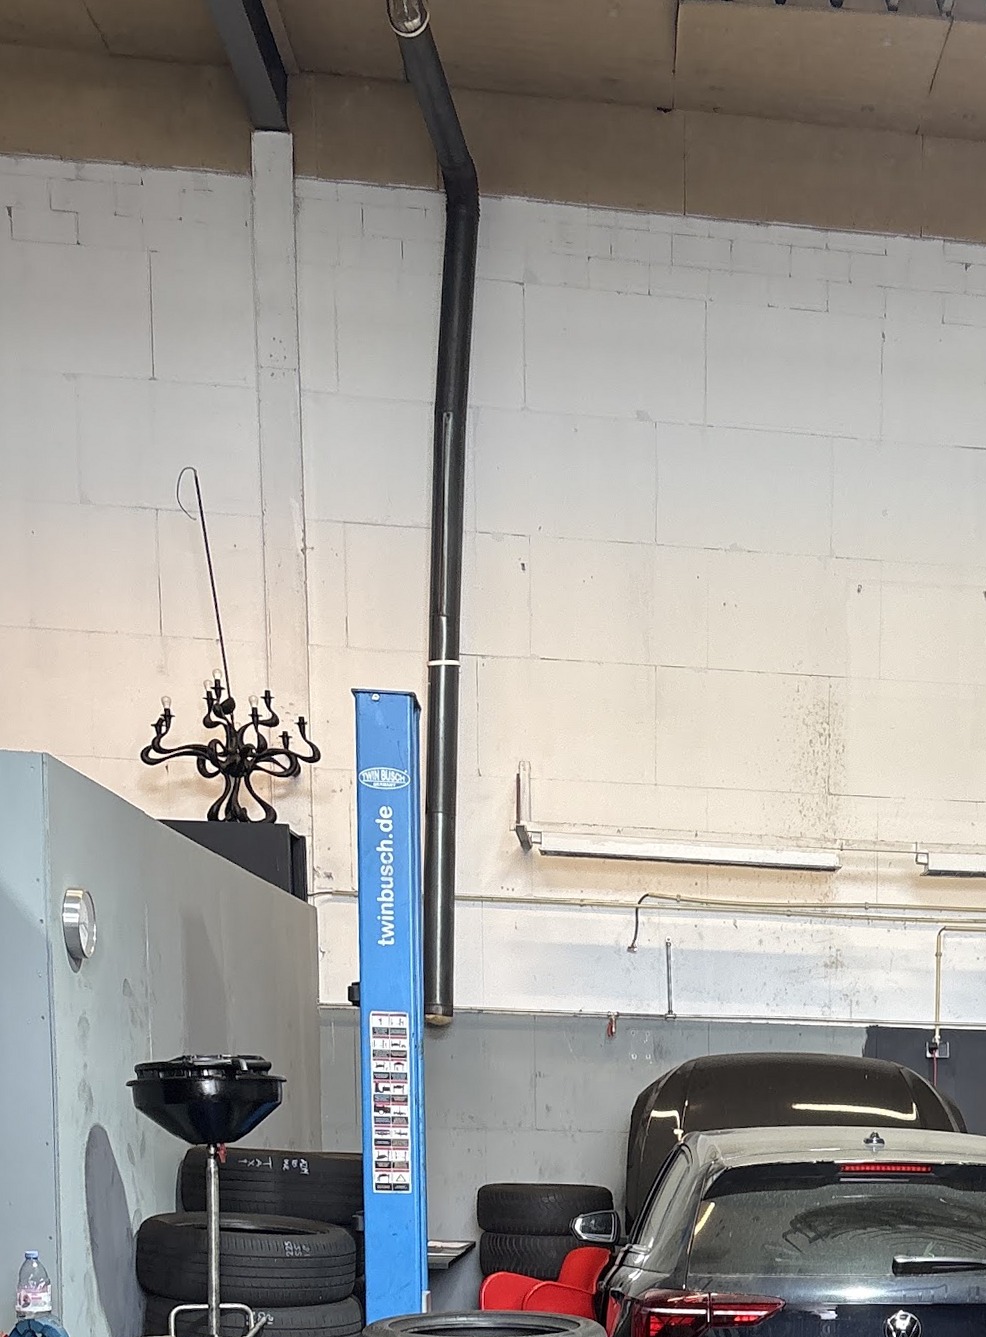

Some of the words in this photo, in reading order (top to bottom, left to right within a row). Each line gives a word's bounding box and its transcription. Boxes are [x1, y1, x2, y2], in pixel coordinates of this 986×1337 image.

[361, 769, 380, 781] TWIN
[381, 769, 406, 783] BUSCH
[377, 804, 395, 947] twinbusch.de
